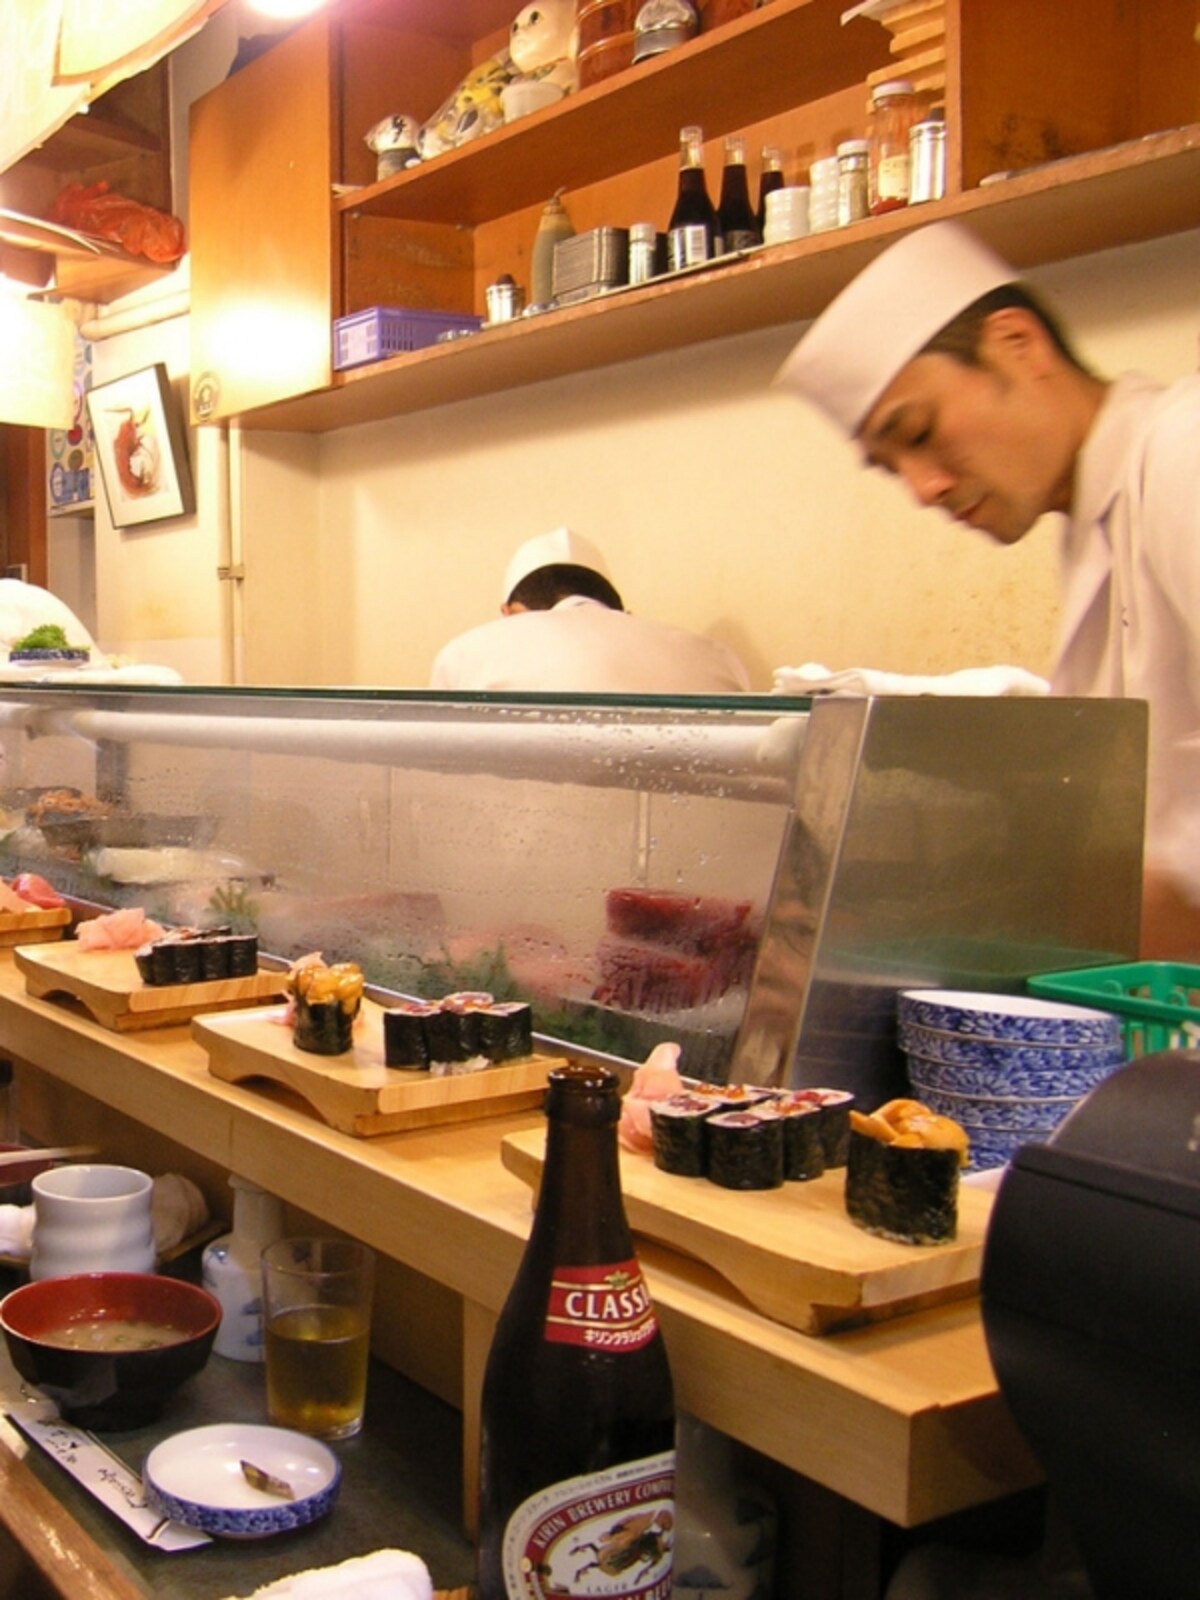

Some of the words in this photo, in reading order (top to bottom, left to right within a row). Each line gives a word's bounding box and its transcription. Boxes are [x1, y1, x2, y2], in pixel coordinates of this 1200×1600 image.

[565, 1284, 649, 1319] CLASSI
[533, 1515, 567, 1549] KIRIN
[567, 1489, 631, 1522] BREWERY
[586, 1583, 628, 1594] LAGER
